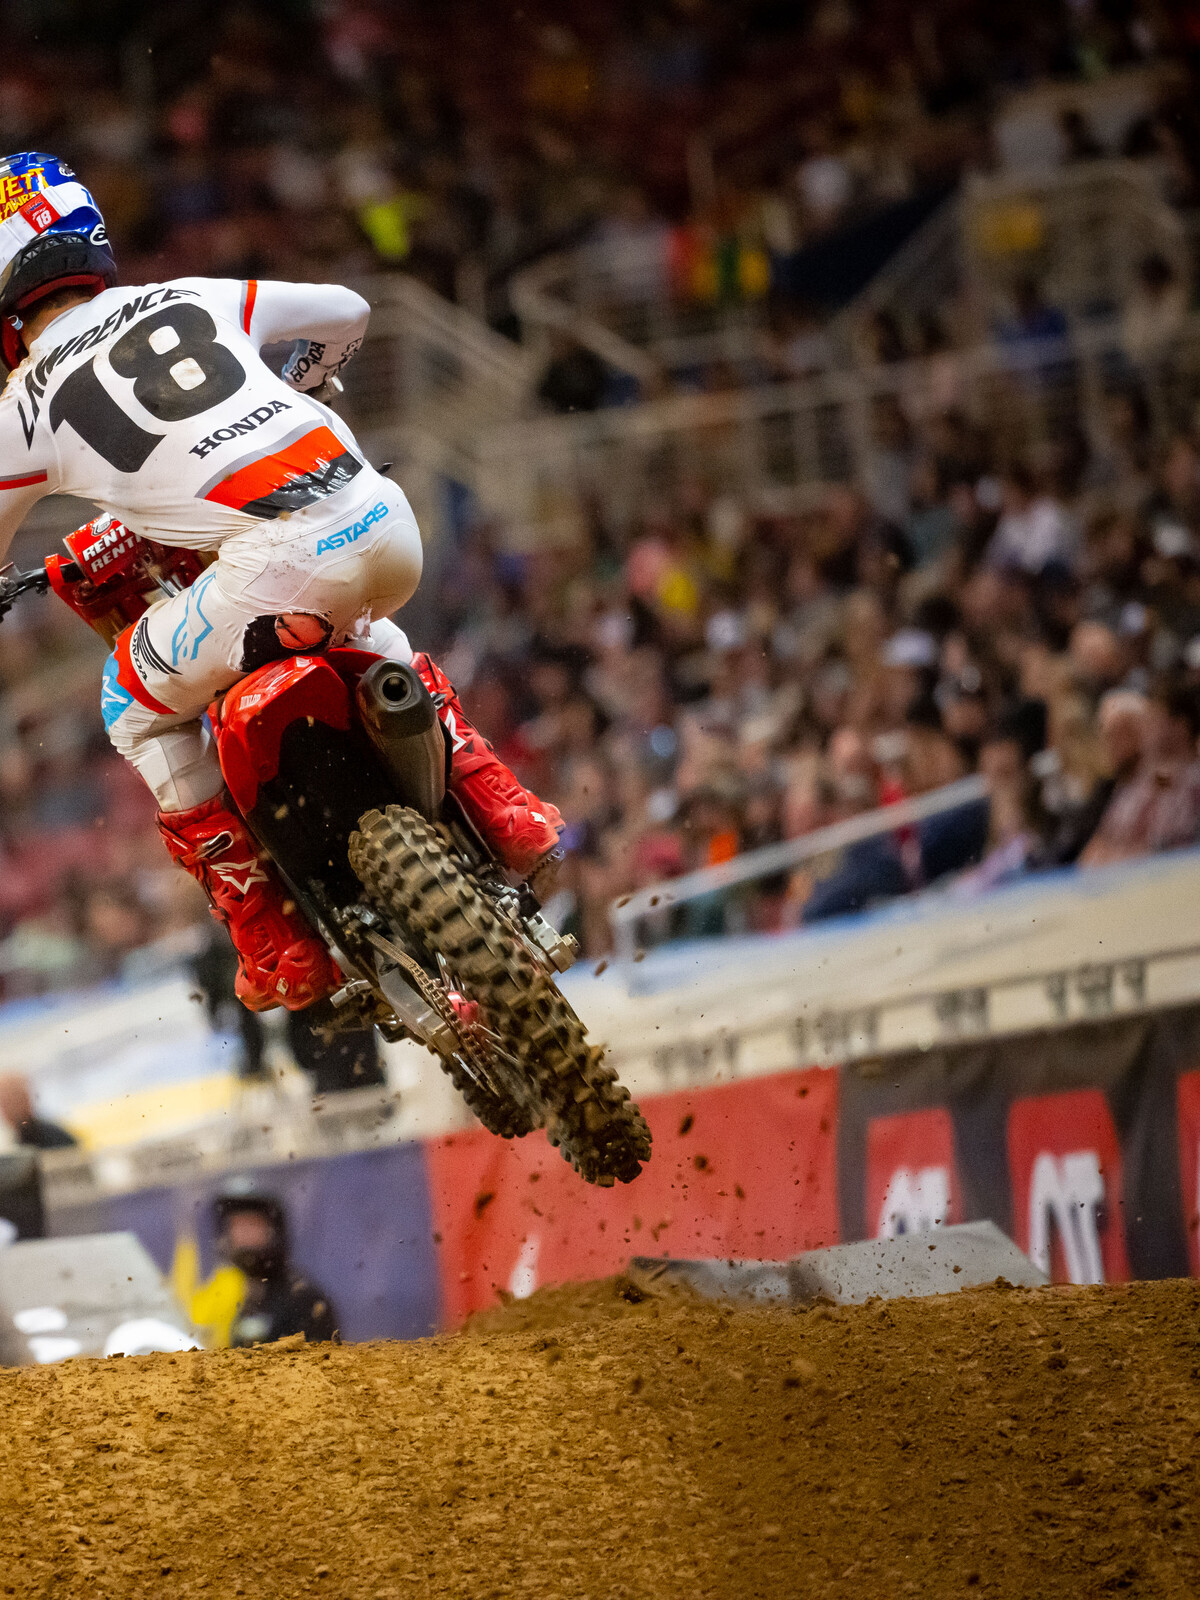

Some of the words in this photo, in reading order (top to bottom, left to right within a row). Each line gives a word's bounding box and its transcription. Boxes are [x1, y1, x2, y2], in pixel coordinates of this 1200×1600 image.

[35, 209, 52, 228] 18
[17, 288, 201, 451] LAWRENCE
[50, 303, 246, 473] 18
[189, 400, 293, 460] HONDA
[316, 501, 389, 556] ASTARS
